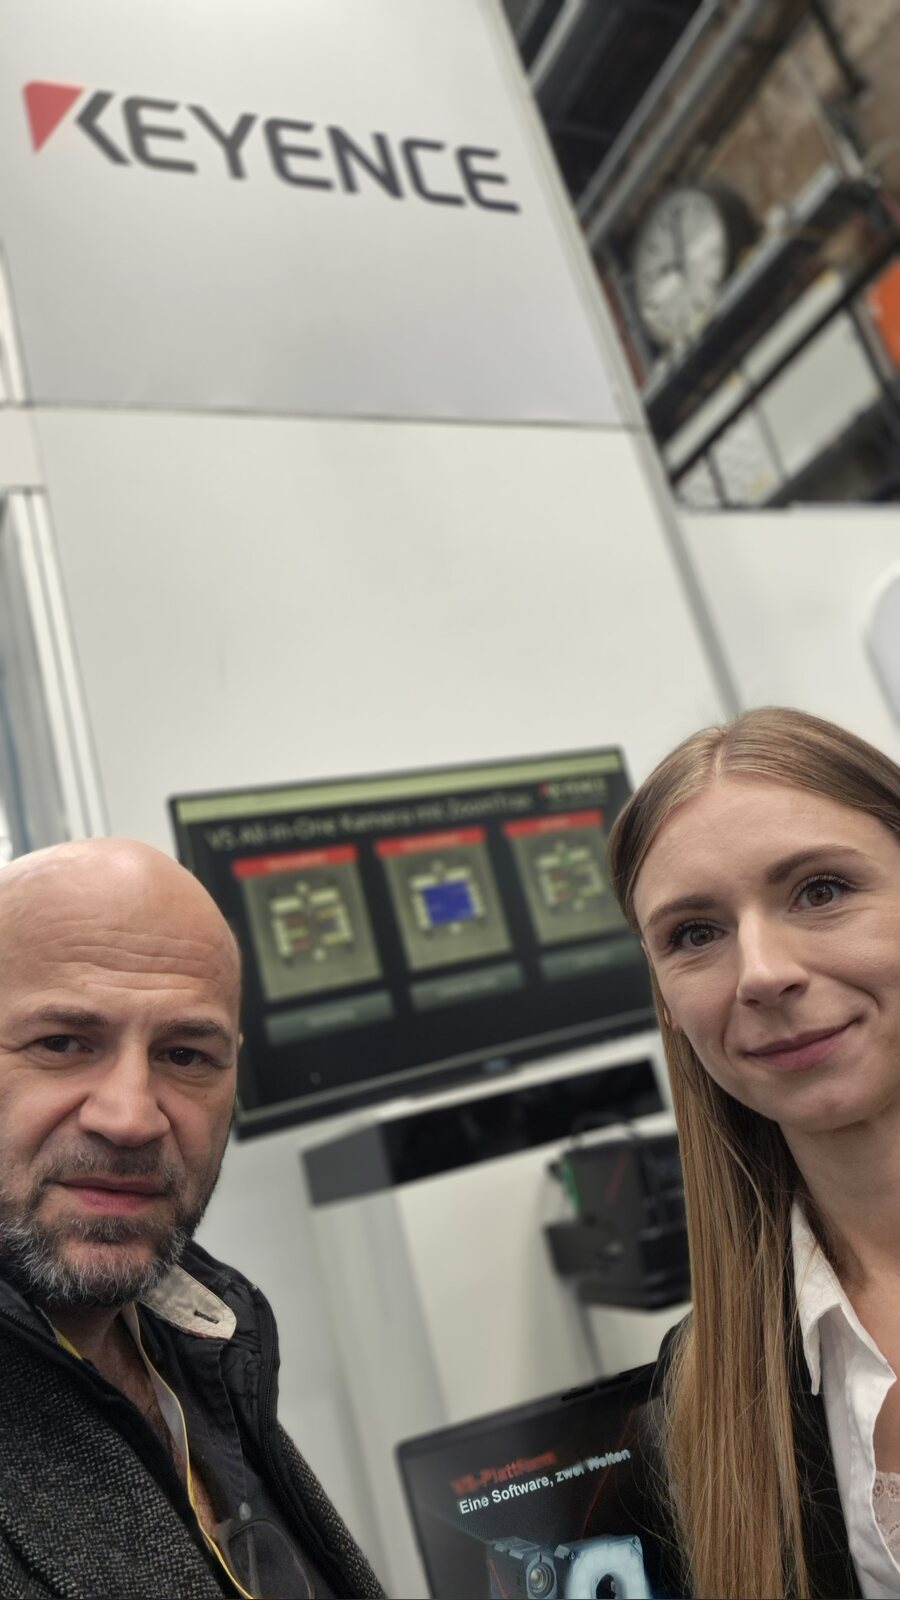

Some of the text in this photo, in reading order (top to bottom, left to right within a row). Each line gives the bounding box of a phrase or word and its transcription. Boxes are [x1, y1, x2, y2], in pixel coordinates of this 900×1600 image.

[22, 80, 521, 215] KEYENCE
[459, 1448, 631, 1515] Eine Software, zwei Welten
